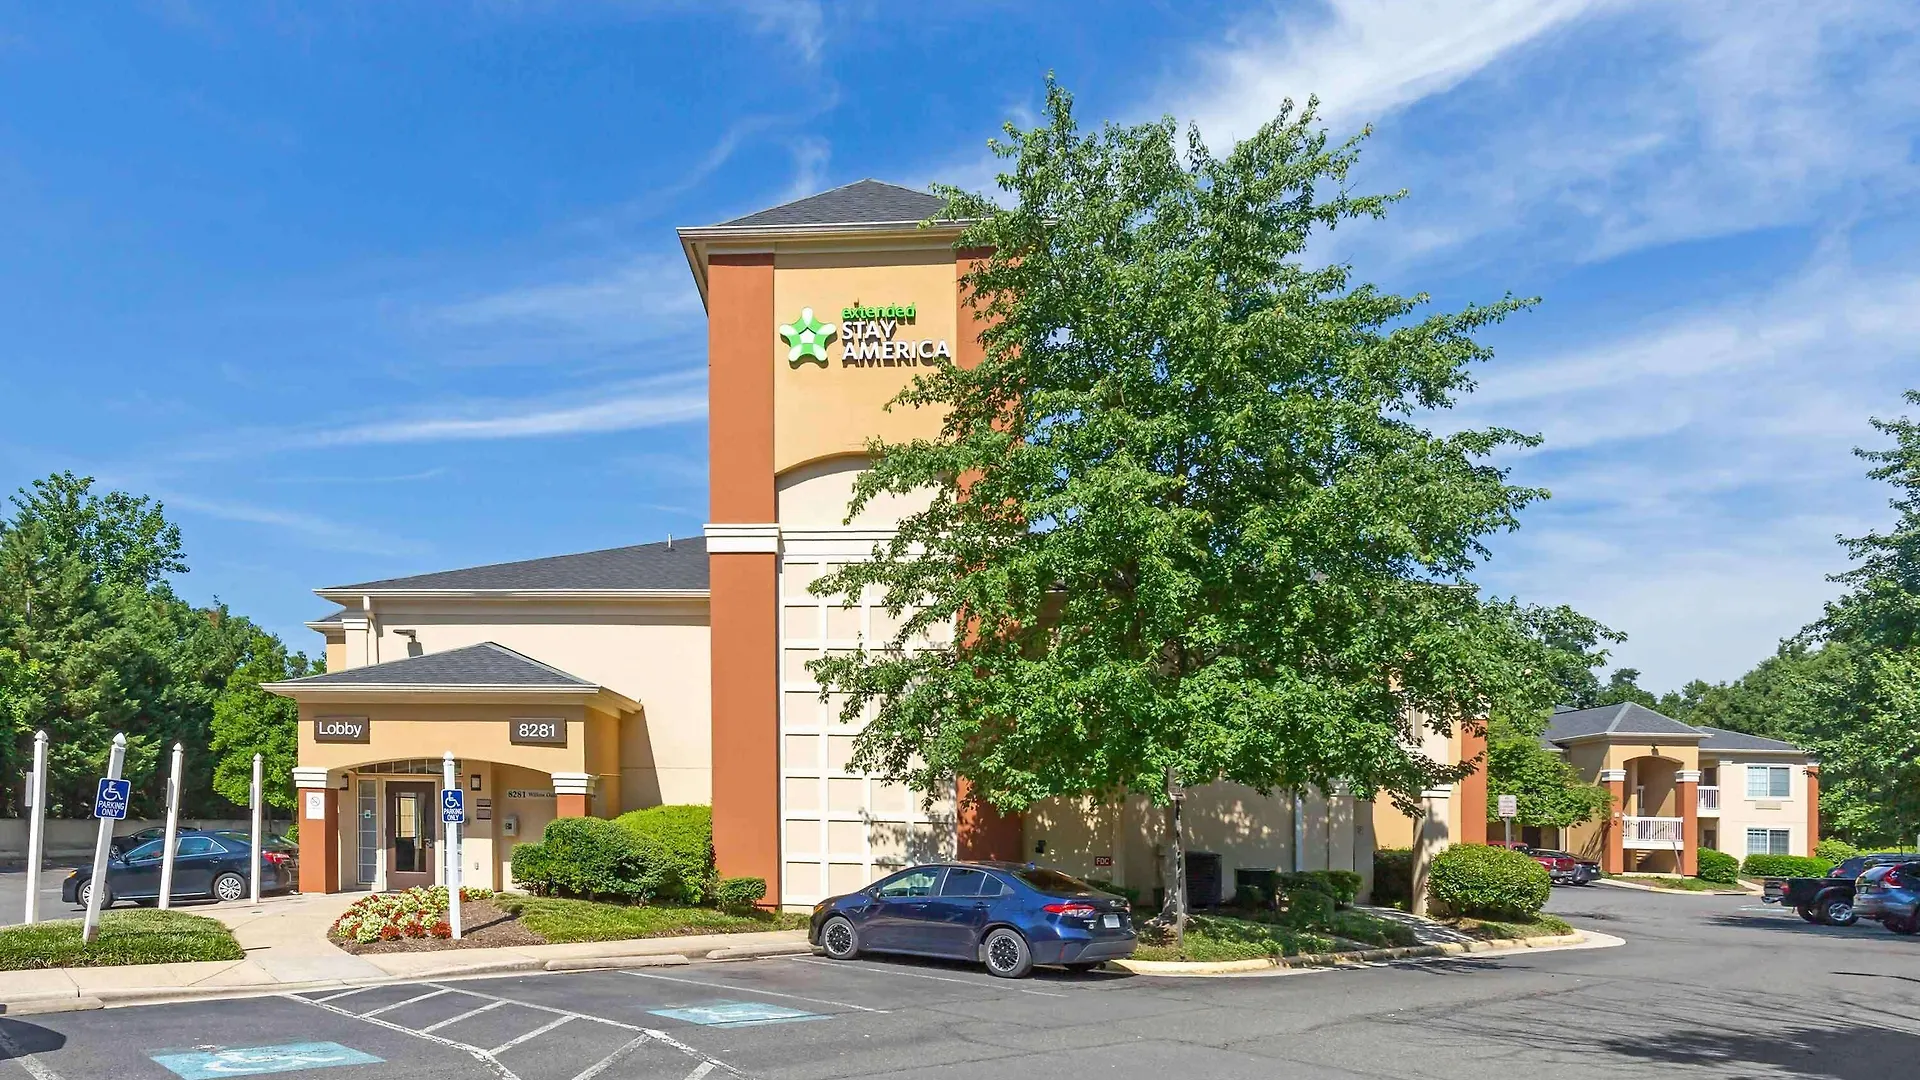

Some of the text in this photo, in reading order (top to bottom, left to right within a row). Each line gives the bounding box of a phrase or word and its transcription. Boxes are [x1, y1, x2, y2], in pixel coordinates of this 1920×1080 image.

[841, 302, 915, 319] extended
[842, 320, 895, 340] STAY
[842, 340, 951, 360] AMERICA
[318, 721, 362, 738] Lobby
[519, 723, 555, 737] 8281
[508, 790, 526, 798] 8281
[98, 800, 125, 811] PARKING
[101, 808, 119, 816] ONLY
[1096, 857, 1110, 865] FDC
